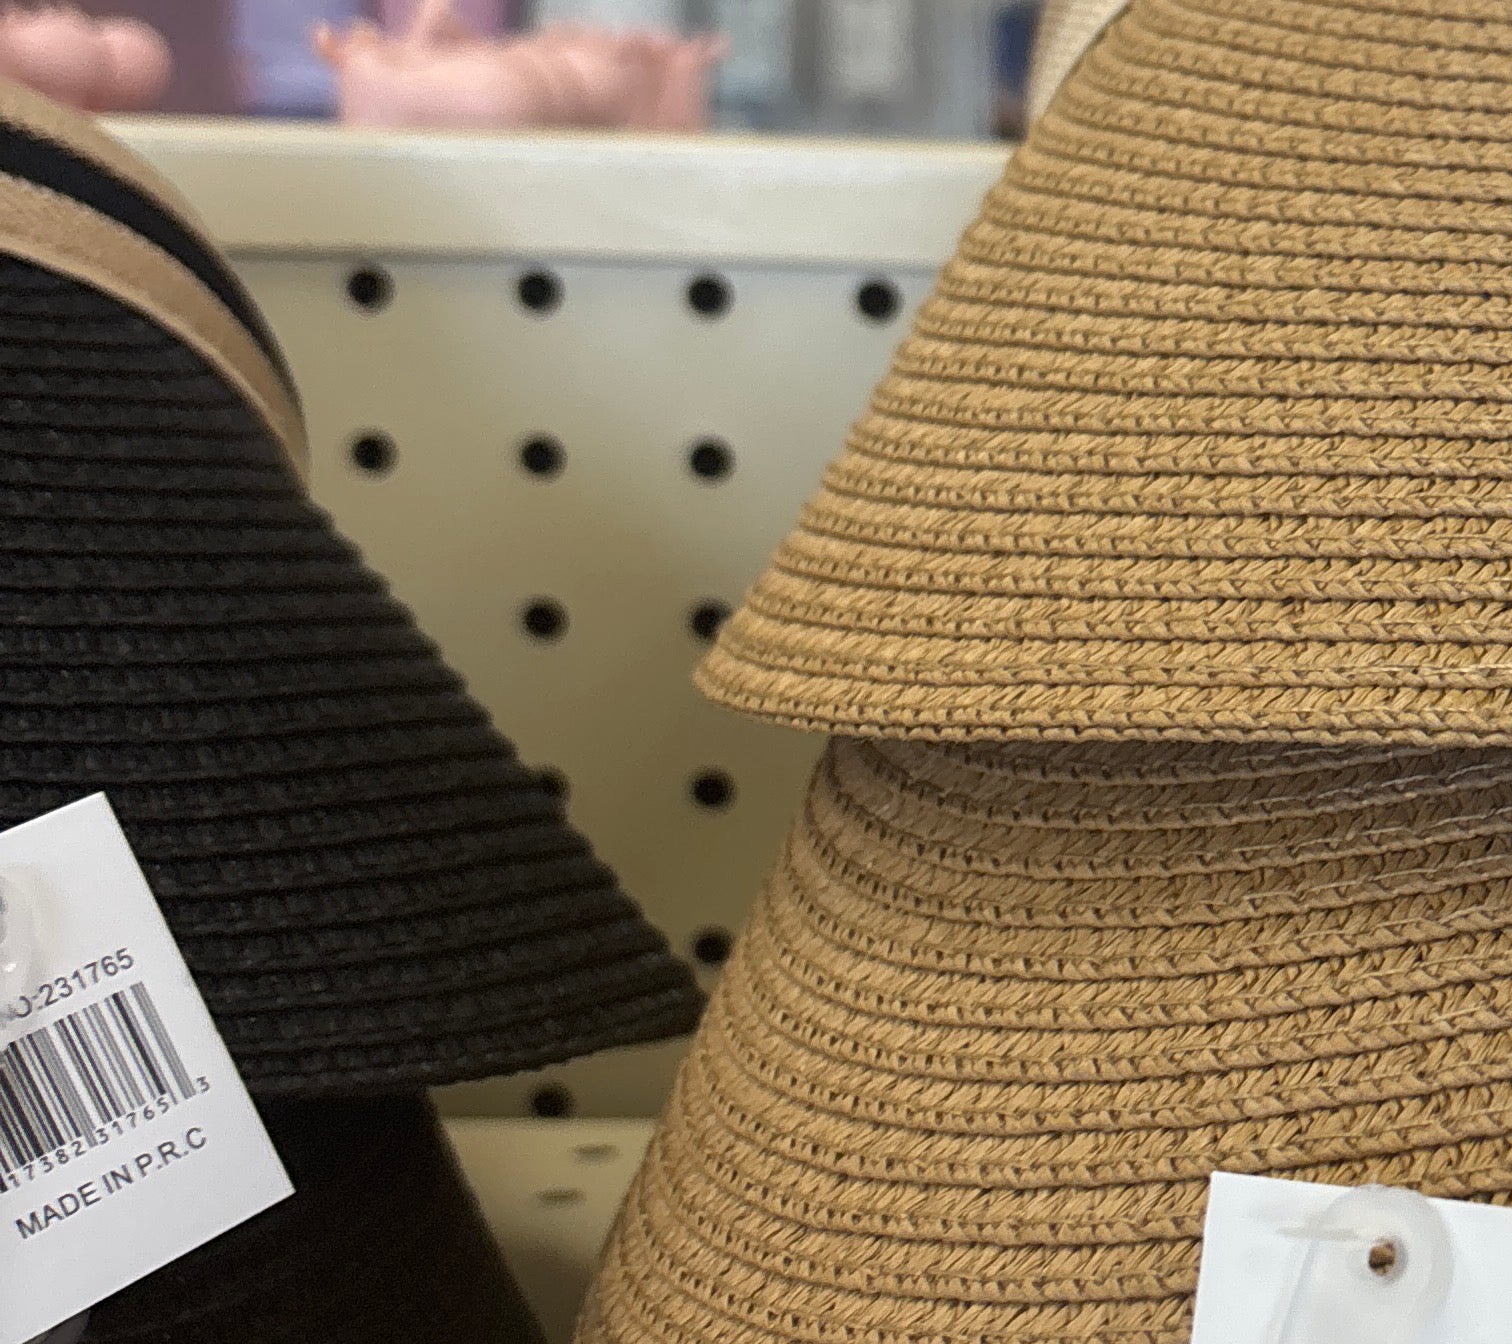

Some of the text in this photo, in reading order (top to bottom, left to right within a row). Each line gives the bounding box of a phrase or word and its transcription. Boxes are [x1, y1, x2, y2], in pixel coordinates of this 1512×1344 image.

[15, 1126, 208, 1240] MADE IN P.R.C
